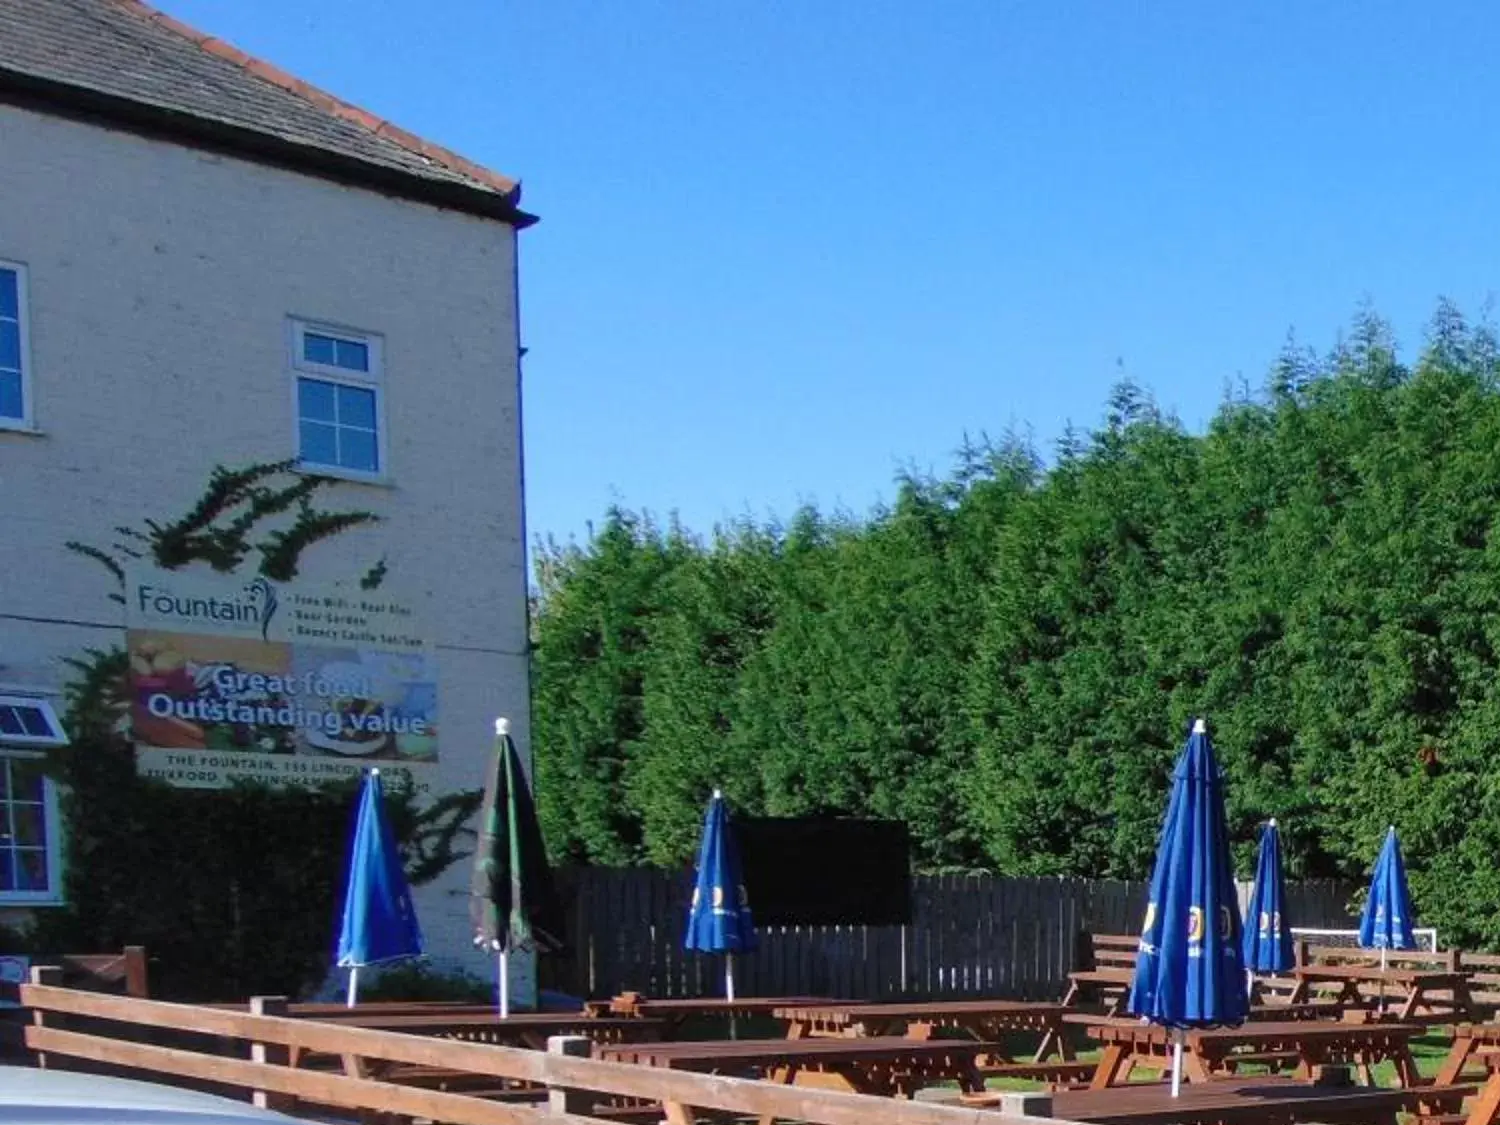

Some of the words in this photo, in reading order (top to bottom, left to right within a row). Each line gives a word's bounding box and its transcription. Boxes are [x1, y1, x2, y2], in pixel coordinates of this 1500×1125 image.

[138, 585, 259, 622] Fountain
[213, 666, 297, 695] Great
[304, 670, 369, 699] food
[147, 692, 341, 734] Outstanding
[348, 709, 425, 735] value
